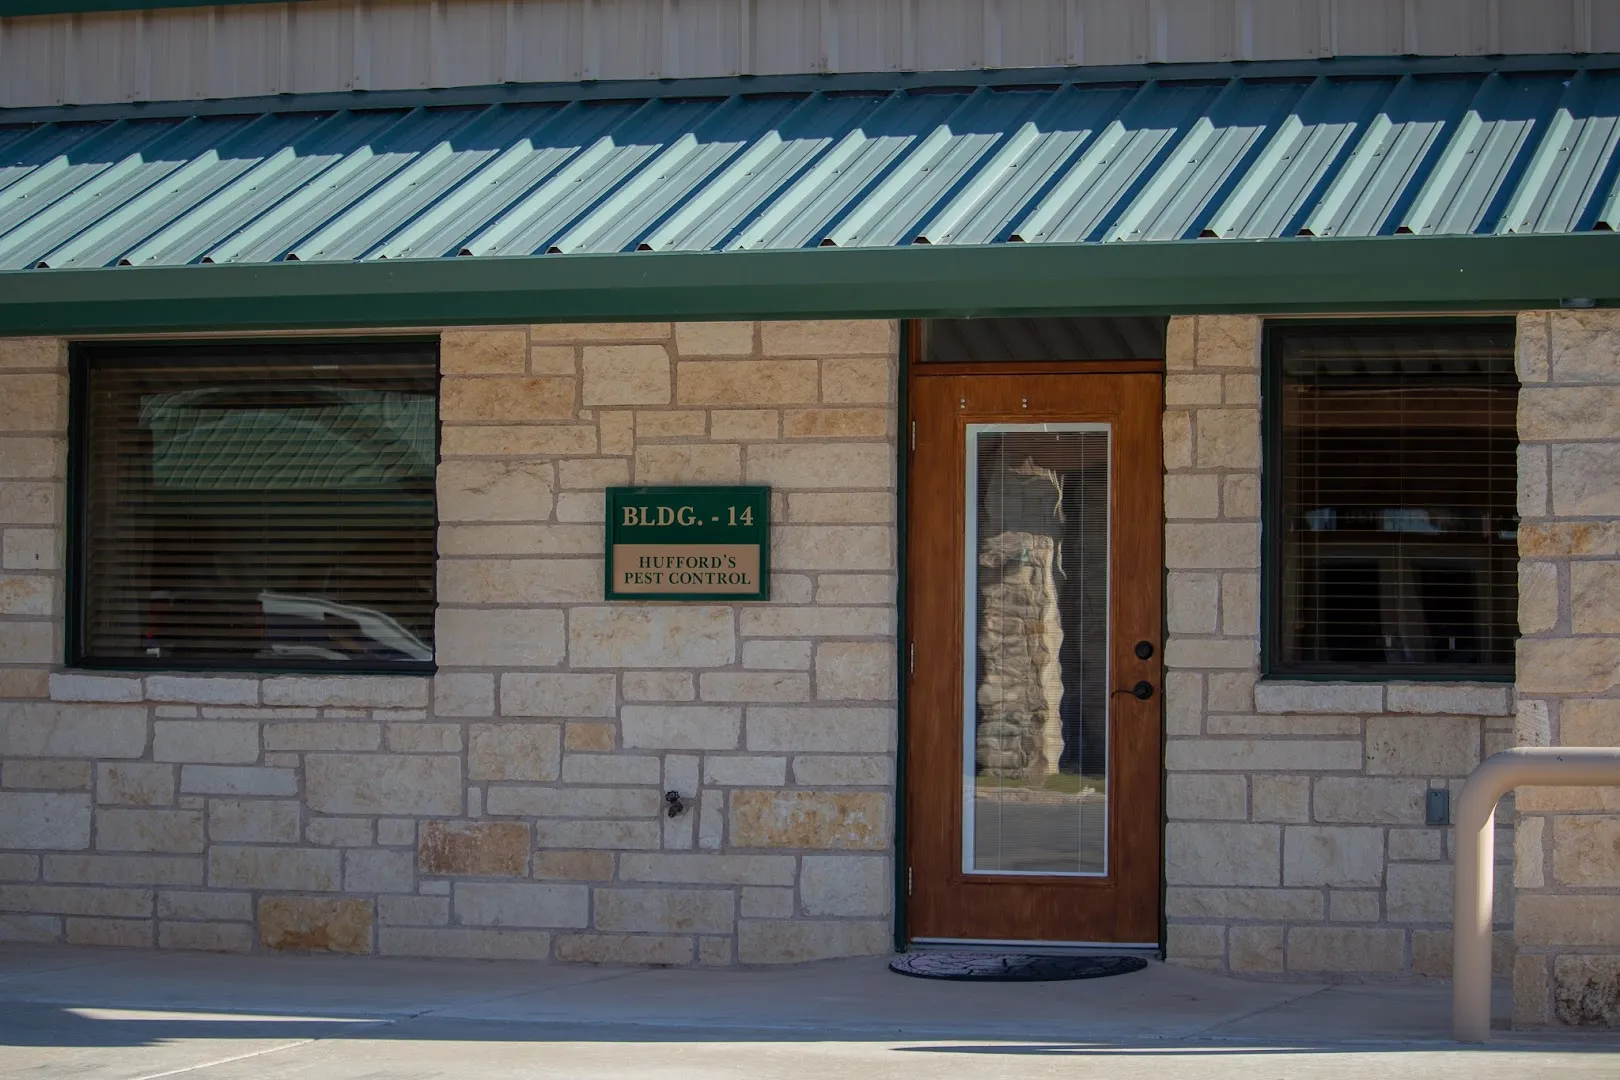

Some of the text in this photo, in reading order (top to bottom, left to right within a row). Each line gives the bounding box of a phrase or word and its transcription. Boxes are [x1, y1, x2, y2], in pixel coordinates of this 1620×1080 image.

[622, 506, 703, 526] BLDG.
[728, 506, 754, 526] 14
[639, 554, 736, 569] HUFFORD'S
[624, 572, 751, 585] PEST CONTROL
